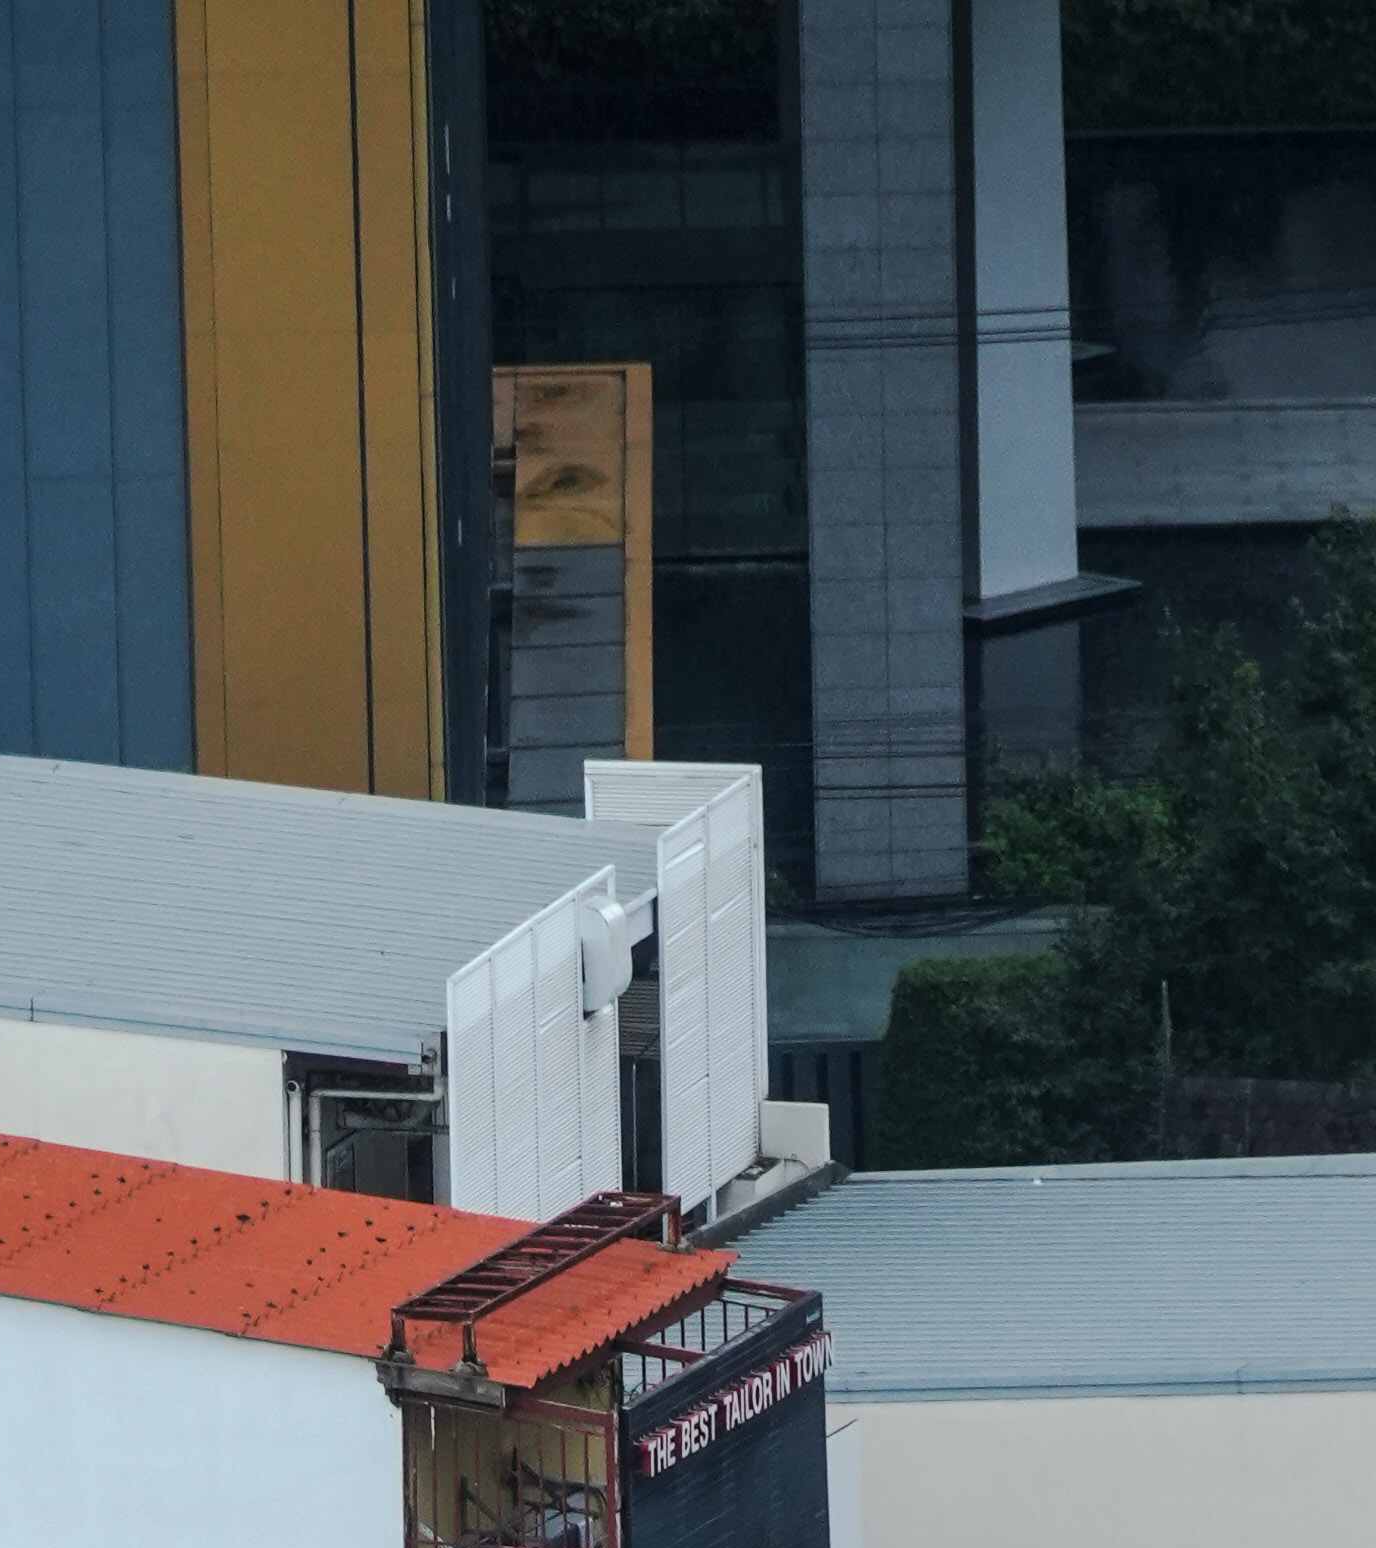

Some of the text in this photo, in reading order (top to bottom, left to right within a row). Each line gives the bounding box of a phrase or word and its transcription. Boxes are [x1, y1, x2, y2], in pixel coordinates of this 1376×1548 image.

[647, 1333, 833, 1478] THE BEST TAILOR IN TOWN
